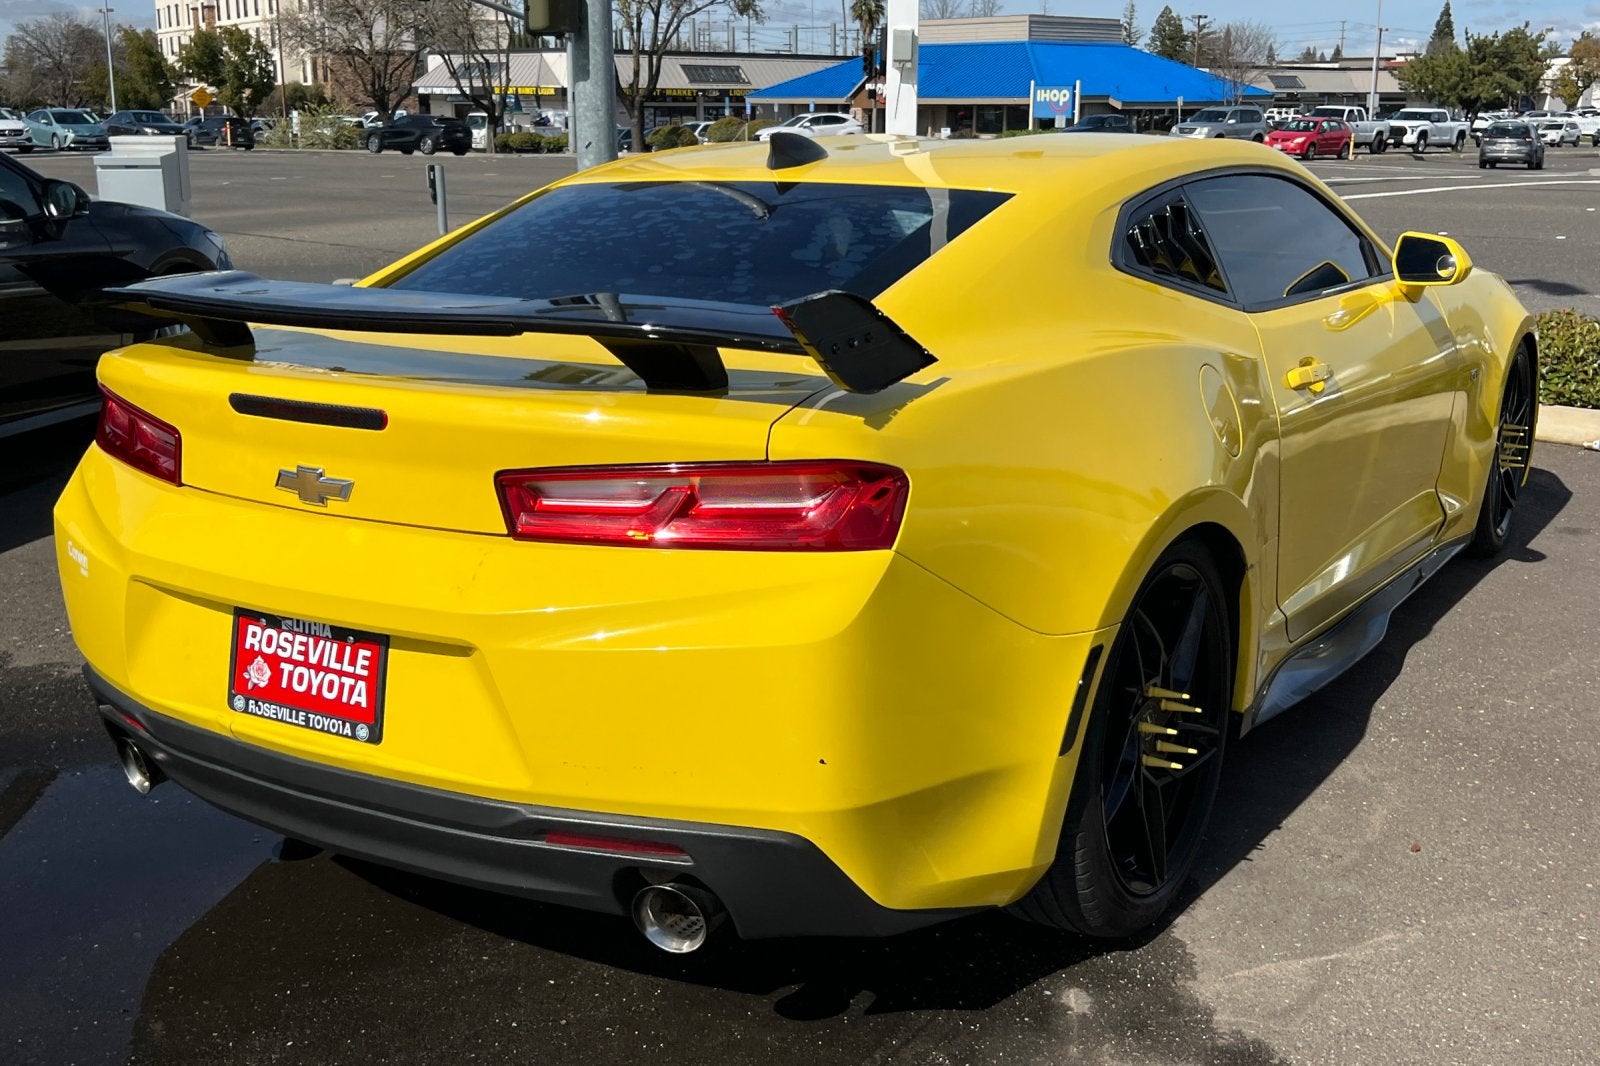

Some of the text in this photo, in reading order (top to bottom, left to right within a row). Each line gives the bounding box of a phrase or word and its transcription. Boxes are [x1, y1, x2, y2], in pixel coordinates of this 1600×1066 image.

[293, 619, 332, 638] LITHIA
[245, 624, 372, 677] ROSEVILLE
[279, 662, 368, 708] TOYOTA
[248, 699, 352, 737] ROSEVILLE TOYOTA
